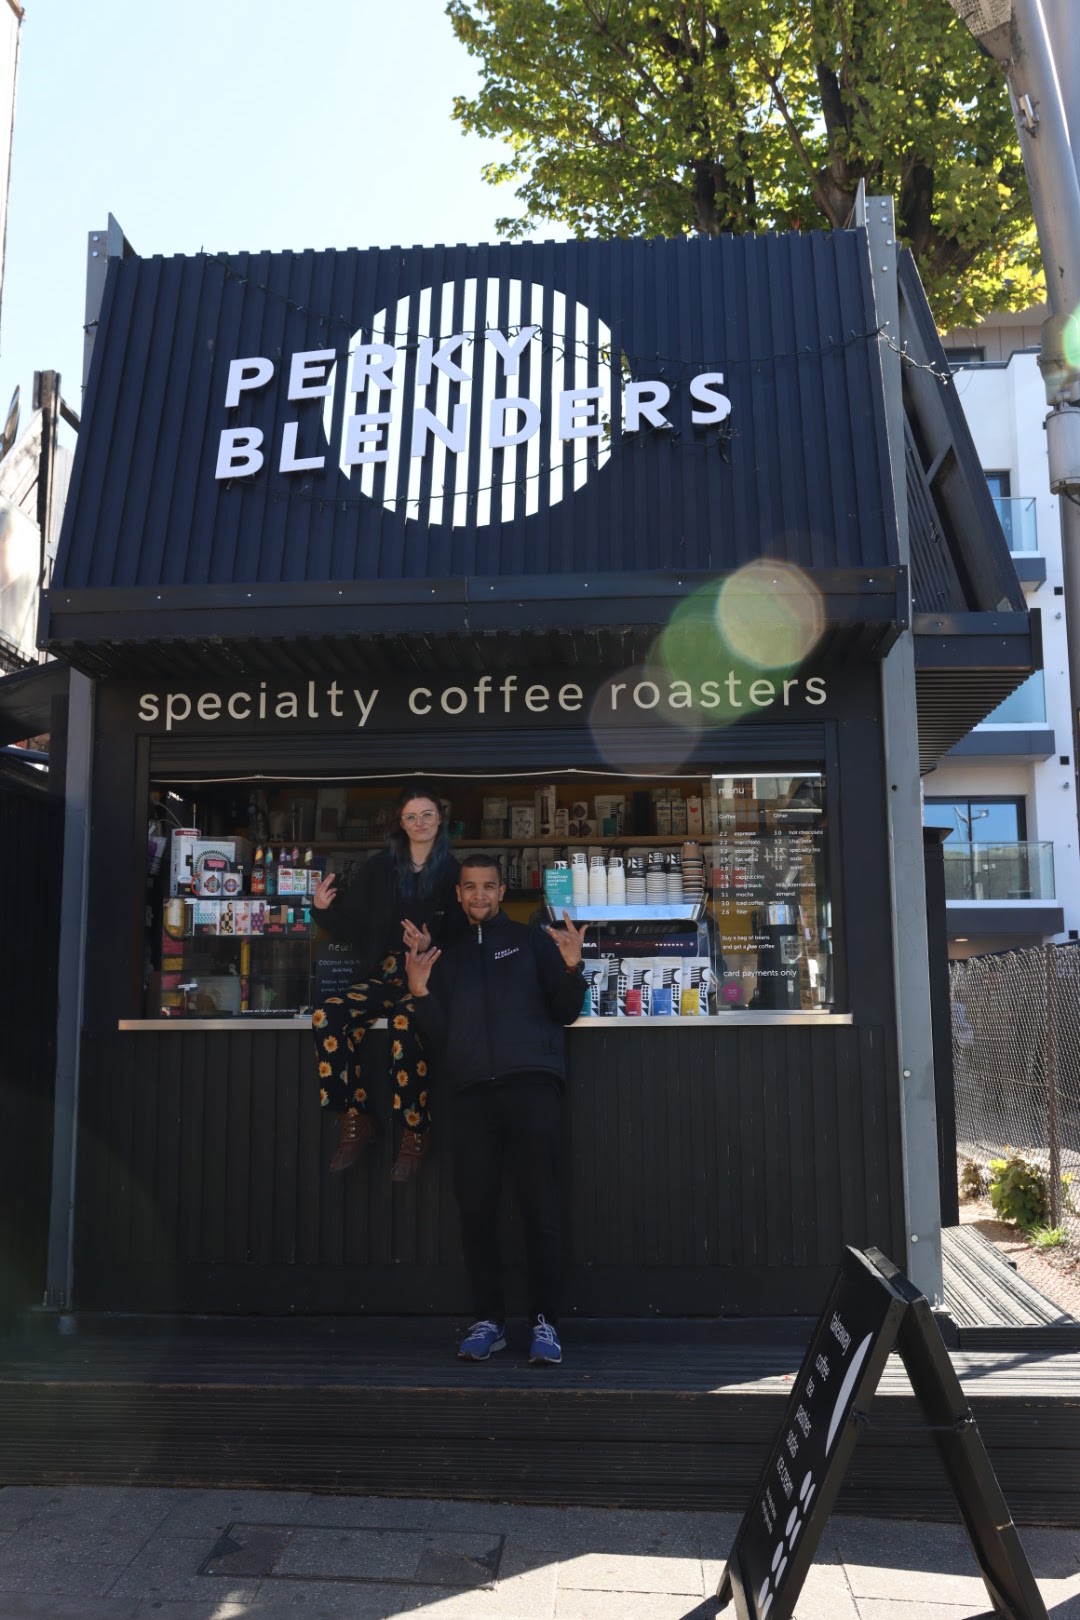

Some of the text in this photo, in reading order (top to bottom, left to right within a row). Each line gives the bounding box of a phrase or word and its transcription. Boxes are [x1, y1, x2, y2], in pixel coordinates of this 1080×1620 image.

[224, 326, 540, 407] PERKY
[215, 372, 732, 479] BLENDERS
[138, 670, 827, 730] specialty coffee roasters
[718, 786, 745, 796] menu
[723, 969, 797, 979] card payments only
[830, 1311, 852, 1356] takeaway
[816, 1353, 830, 1382] coffee
[806, 1375, 815, 1398] tea
[794, 1404, 812, 1438] pastries
[786, 1429, 799, 1459] sodas
[776, 1454, 794, 1501] ice cream
